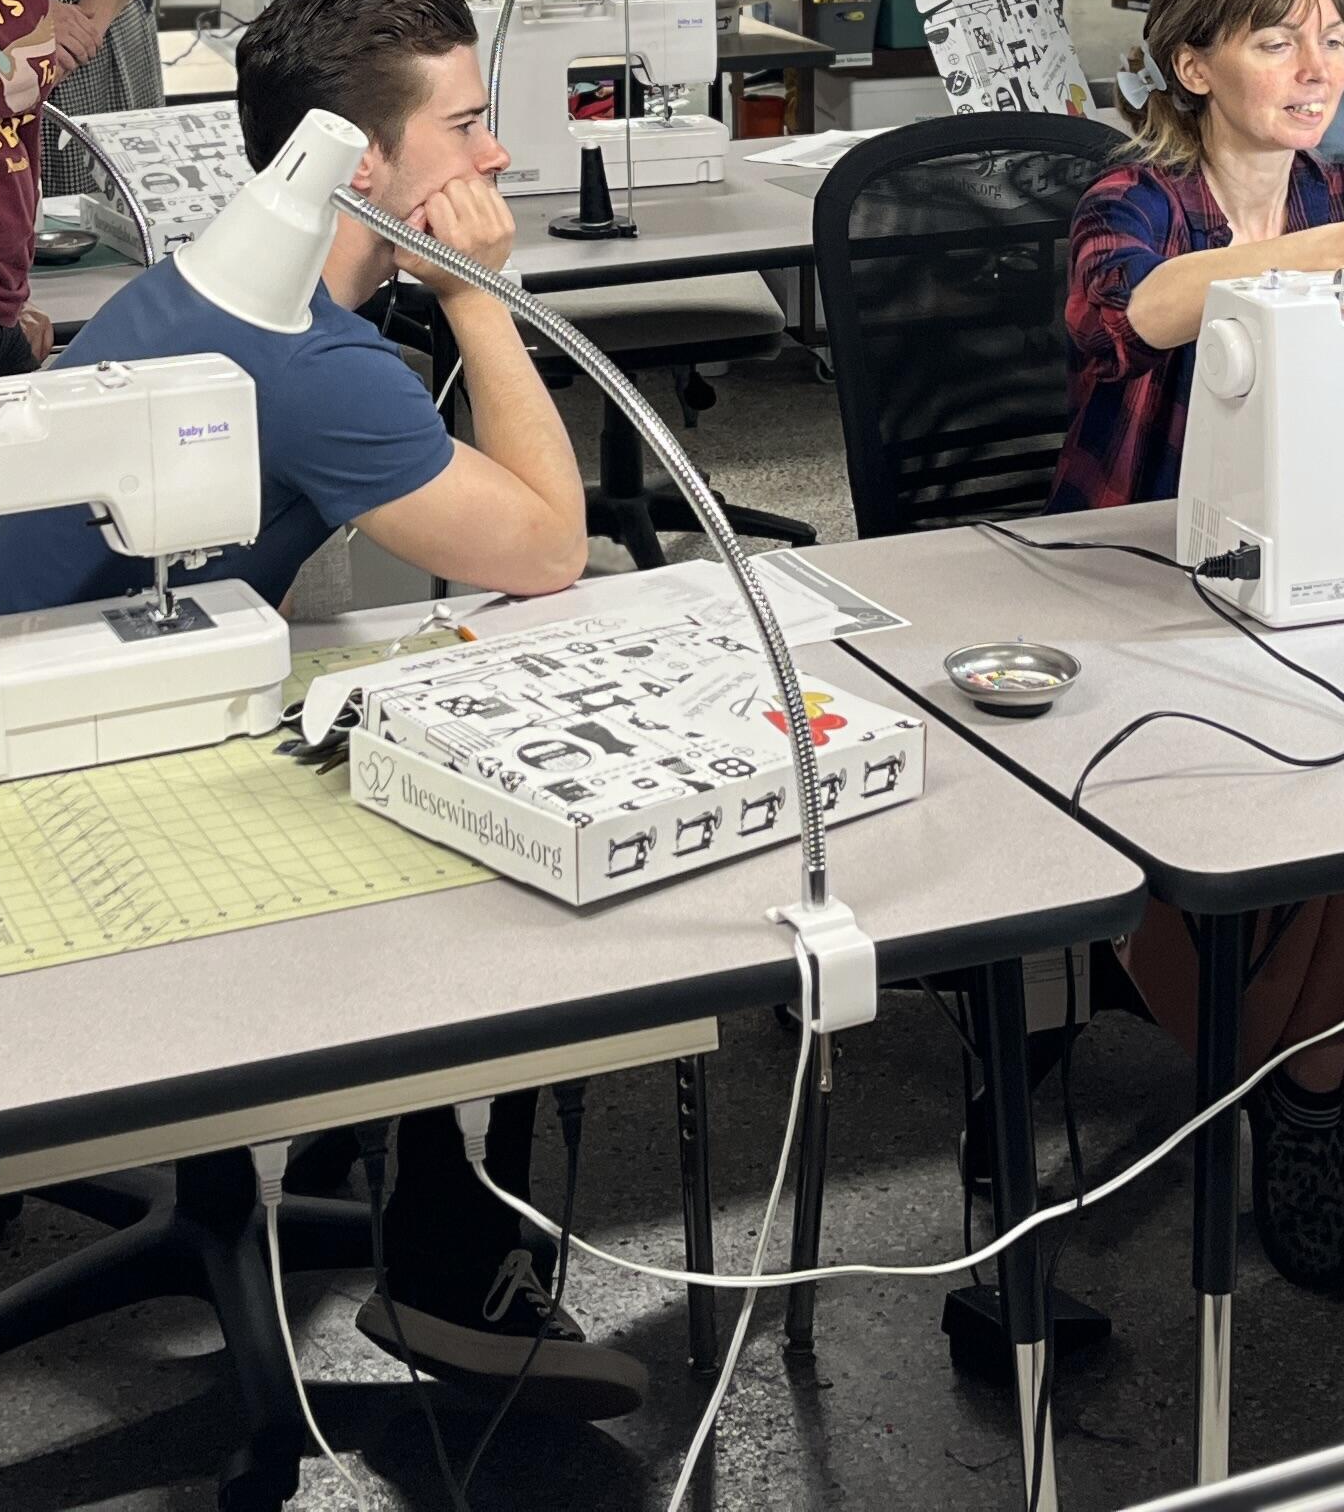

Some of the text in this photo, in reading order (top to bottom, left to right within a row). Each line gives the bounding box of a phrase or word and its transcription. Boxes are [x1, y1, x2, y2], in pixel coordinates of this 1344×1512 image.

[178, 422, 230, 437] baby lock
[401, 773, 564, 880] thesewinglabs.org
